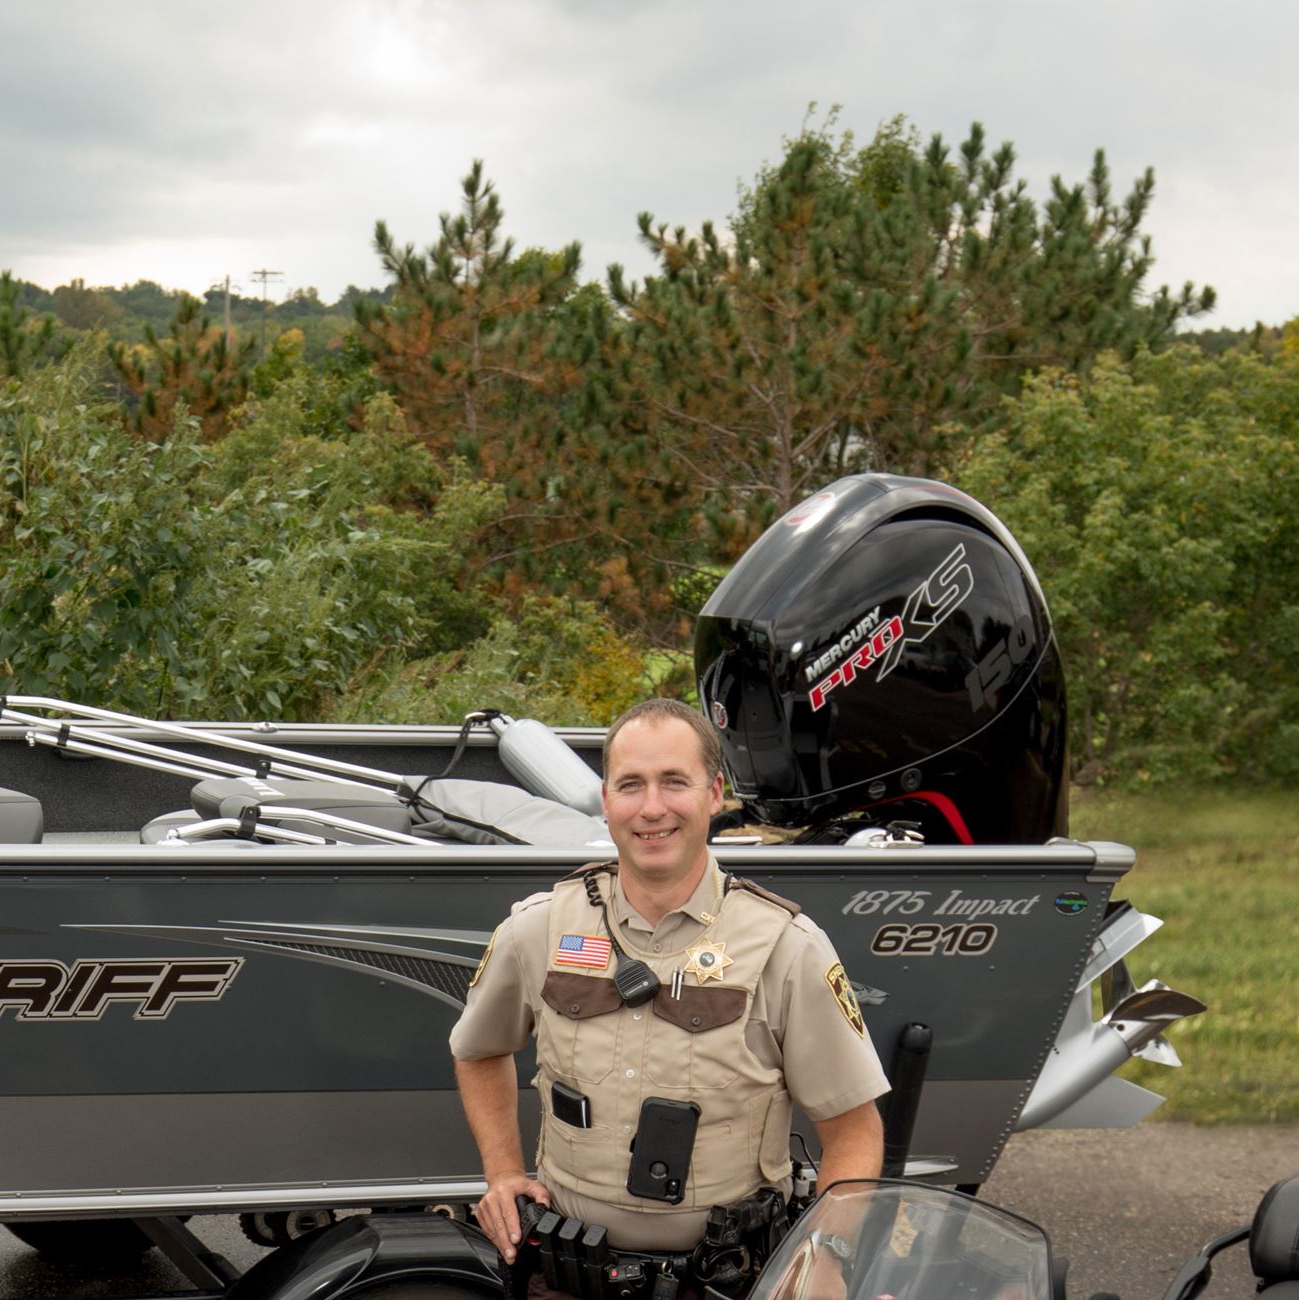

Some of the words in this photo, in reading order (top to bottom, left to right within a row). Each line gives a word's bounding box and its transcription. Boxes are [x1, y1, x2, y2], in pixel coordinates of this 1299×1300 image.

[805, 605, 881, 683] MERCURY
[809, 615, 904, 712] PRO
[876, 542, 974, 683] XS
[964, 614, 1036, 713] 150
[842, 890, 932, 916] 1875
[933, 889, 1041, 921] Impact
[871, 923, 998, 956] 6210
